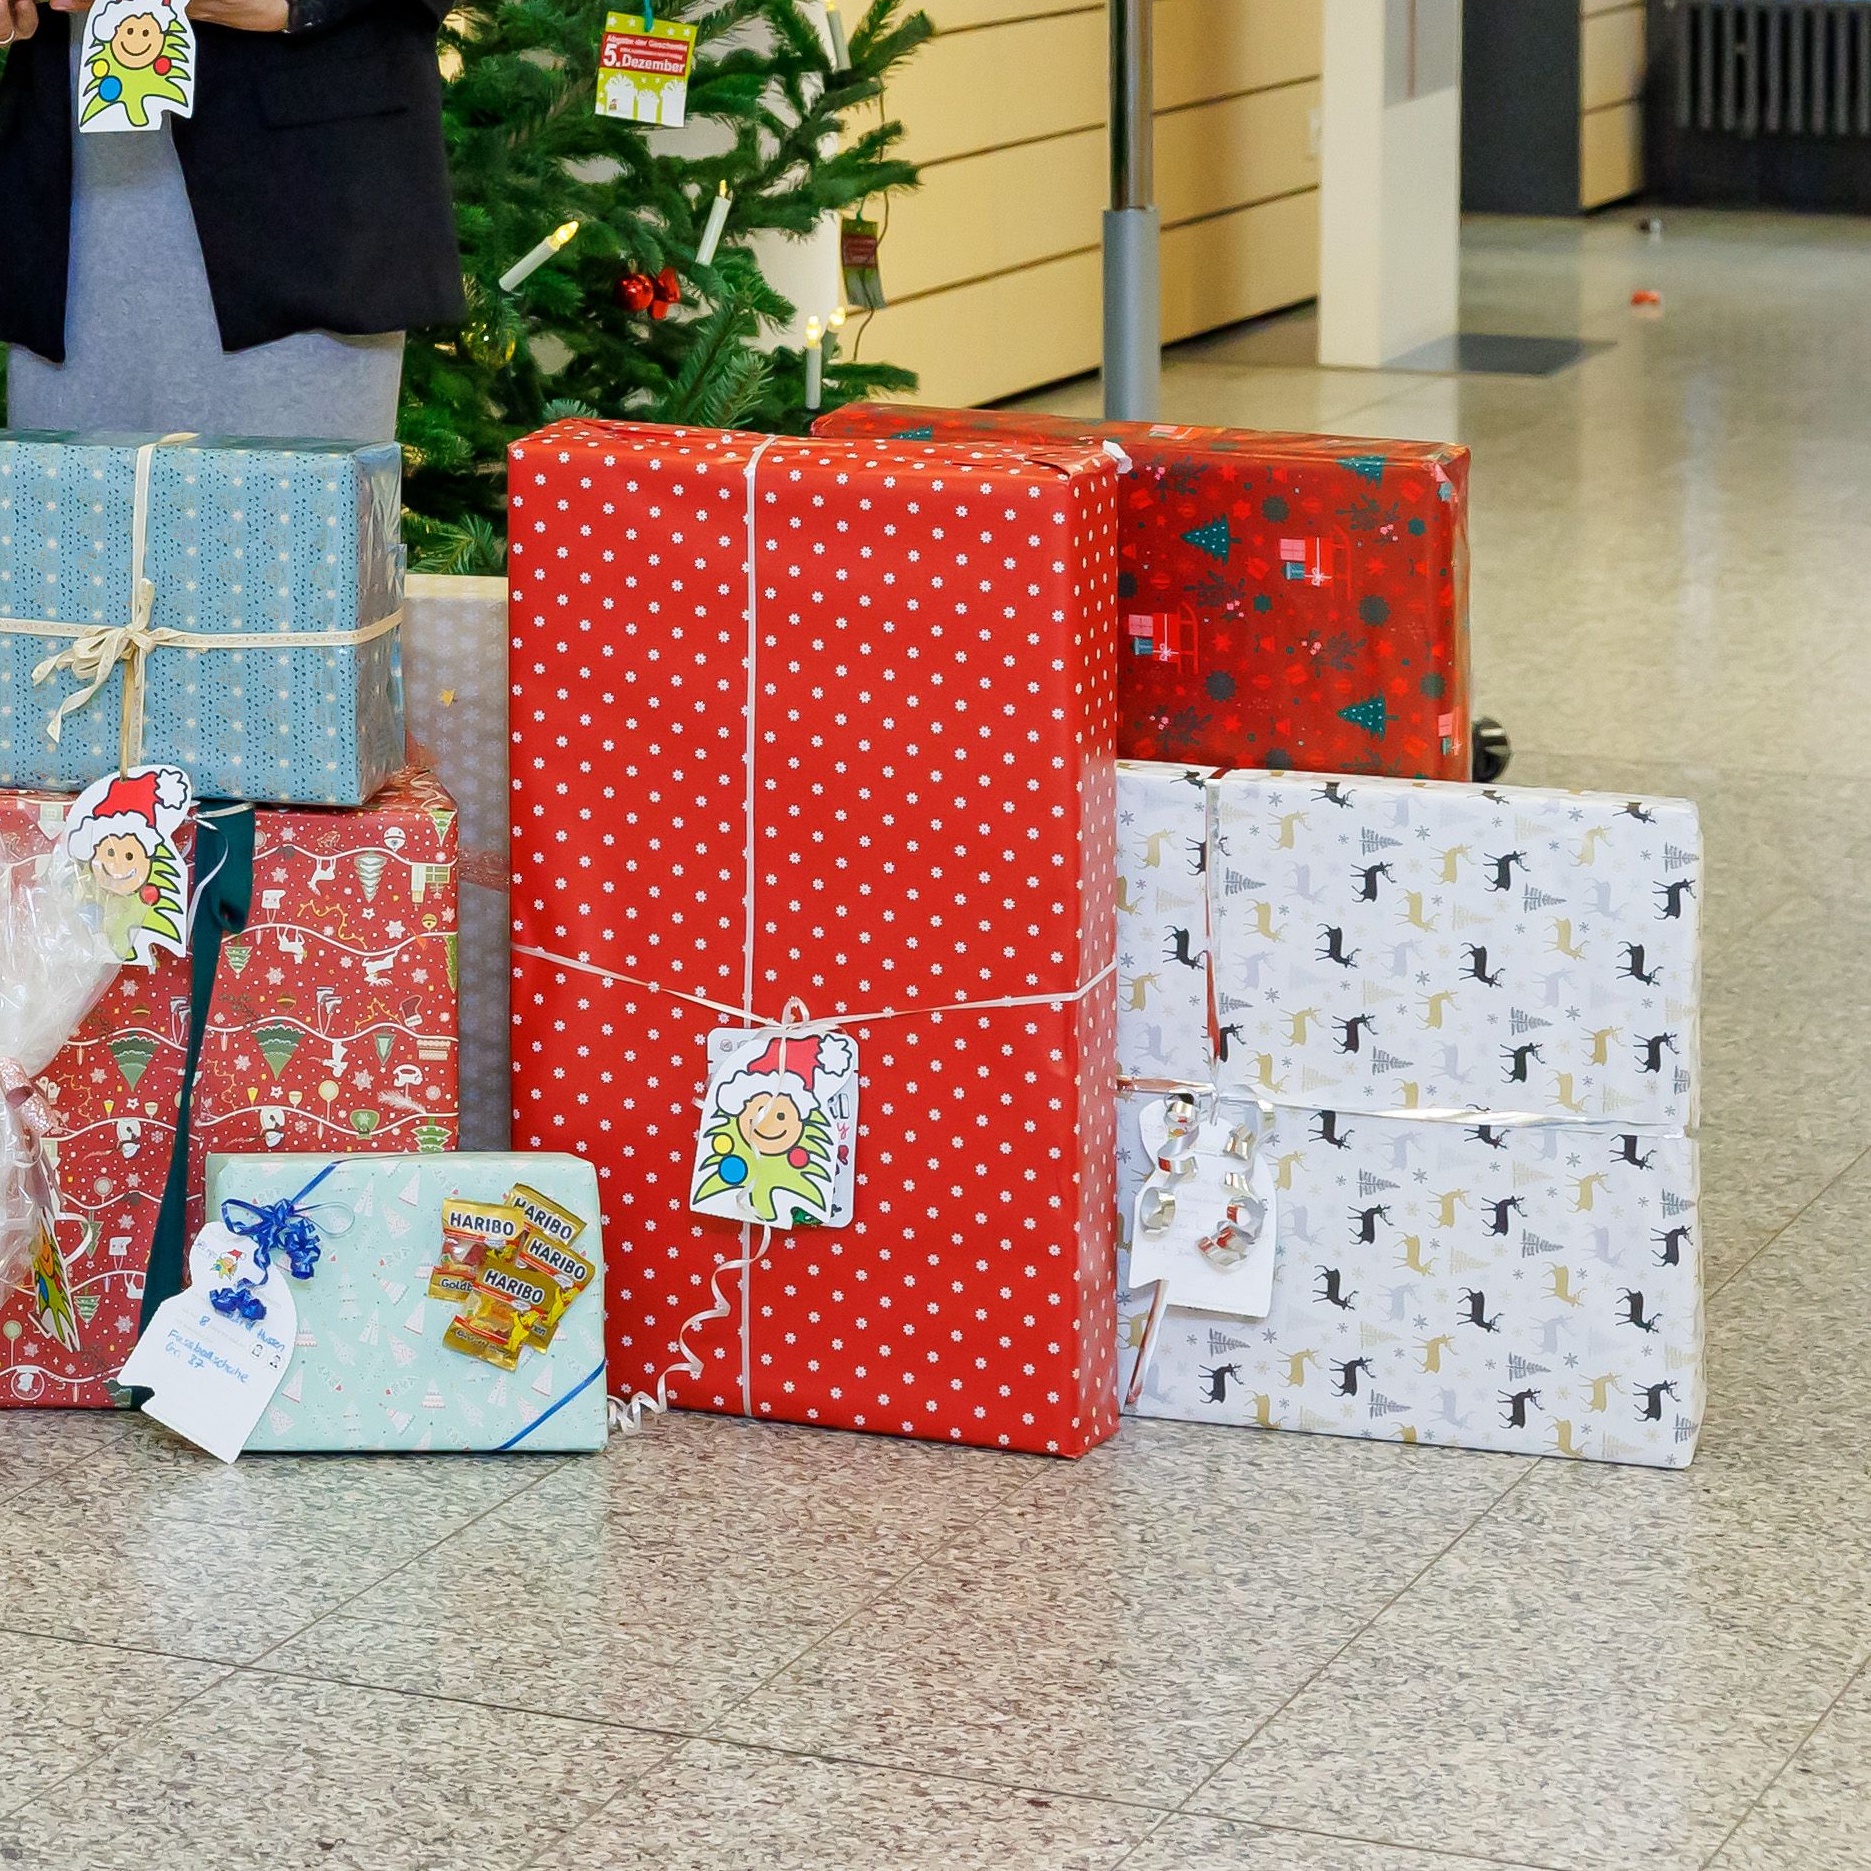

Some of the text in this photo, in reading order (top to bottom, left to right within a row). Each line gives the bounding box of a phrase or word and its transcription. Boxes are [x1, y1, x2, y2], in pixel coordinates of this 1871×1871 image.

[603, 43, 621, 67] 5.
[622, 55, 685, 73] Dezember
[449, 1211, 515, 1236] HARIBO
[514, 1197, 573, 1240] HARIBO
[529, 1238, 586, 1280] HARIBO
[441, 1278, 473, 1292] Goldb
[484, 1269, 544, 1304] HARIBO
